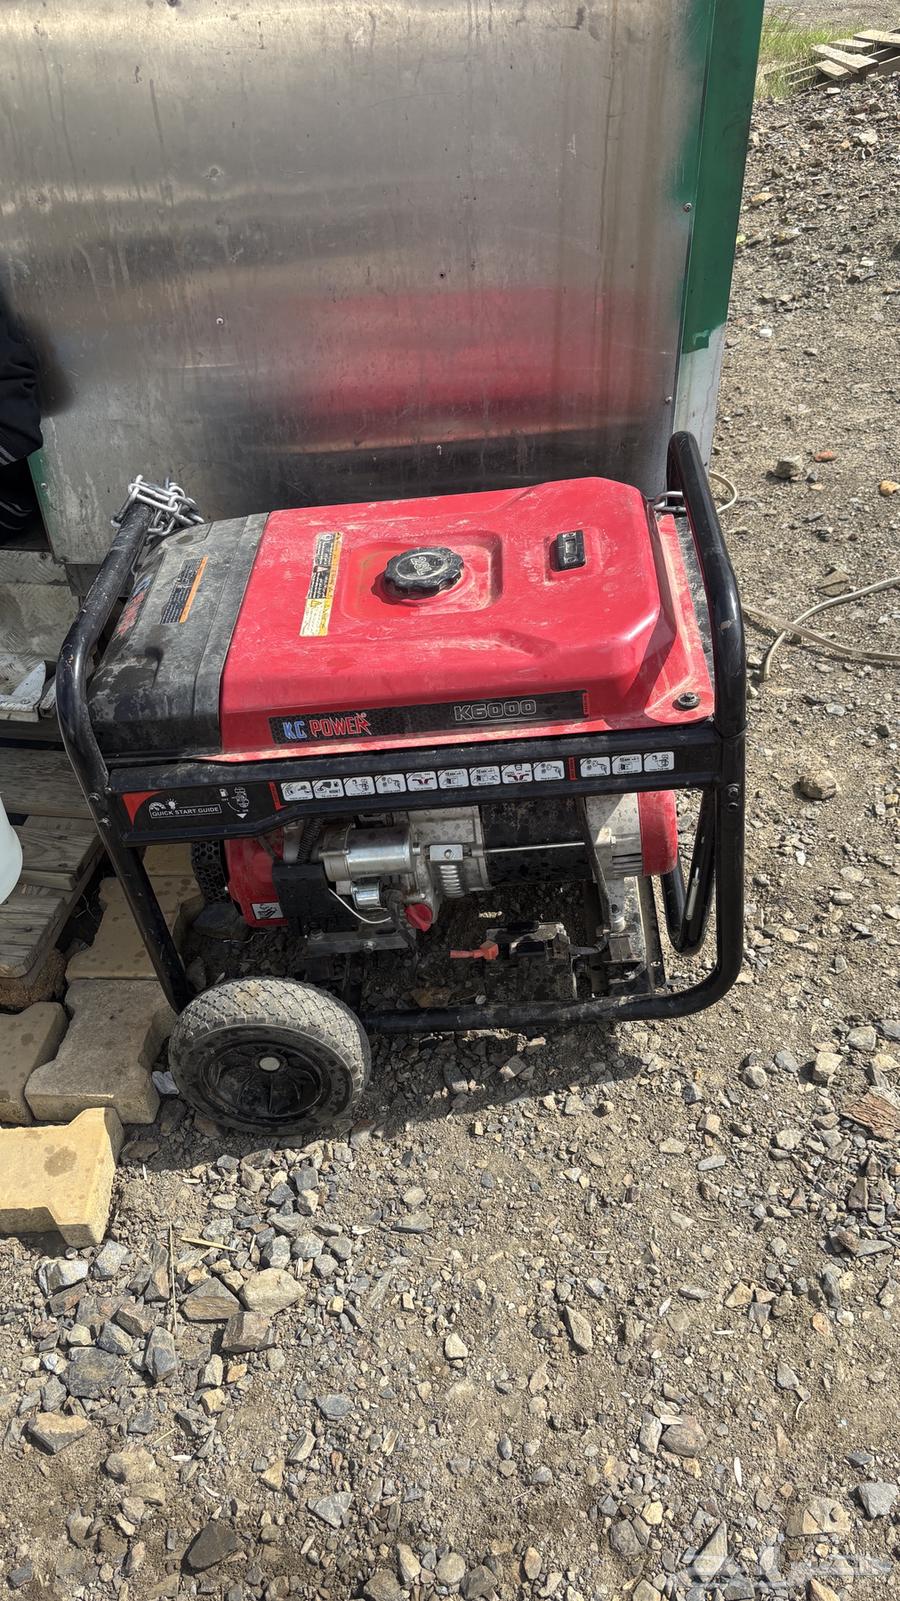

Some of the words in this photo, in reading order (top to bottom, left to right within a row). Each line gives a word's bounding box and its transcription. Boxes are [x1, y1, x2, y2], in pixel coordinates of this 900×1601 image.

[453, 700, 537, 721] K6000
[282, 720, 308, 739] KC
[309, 713, 371, 737] POWER
